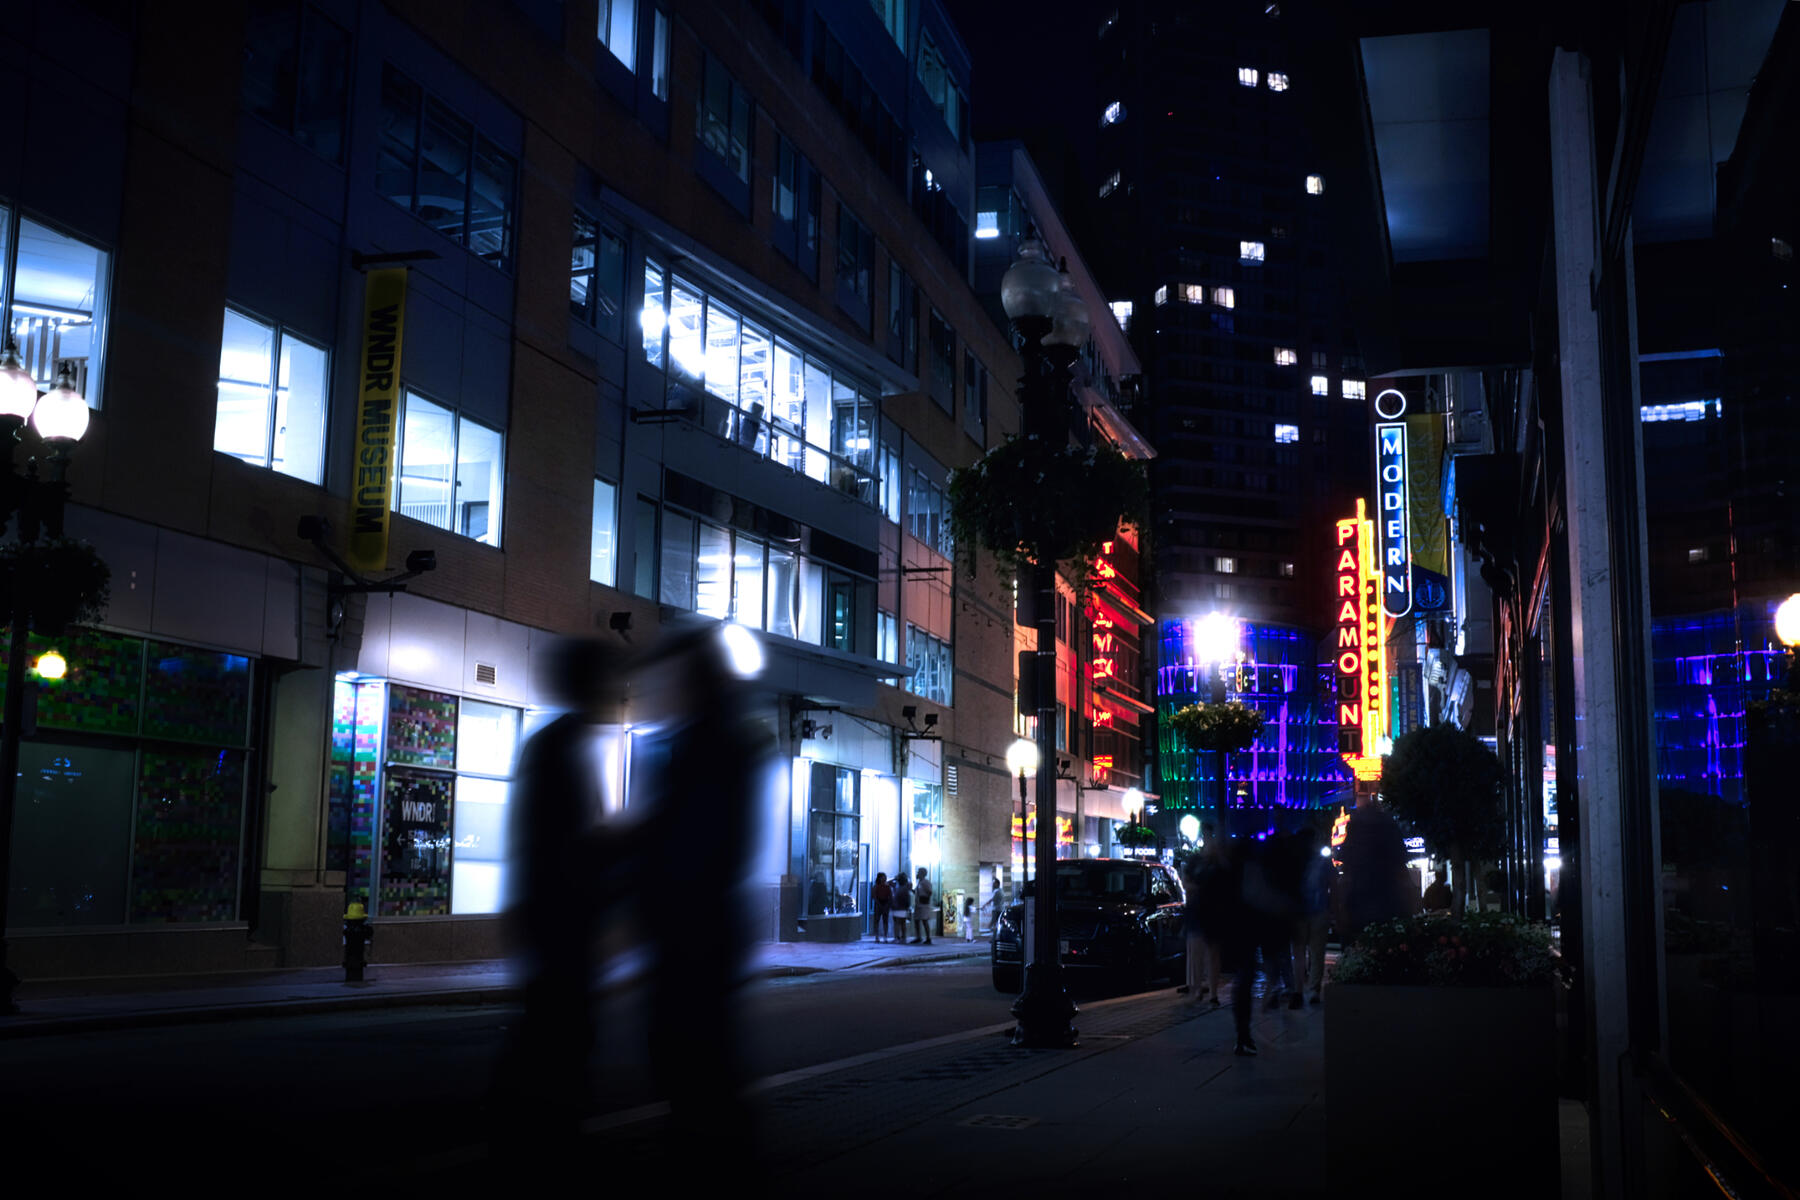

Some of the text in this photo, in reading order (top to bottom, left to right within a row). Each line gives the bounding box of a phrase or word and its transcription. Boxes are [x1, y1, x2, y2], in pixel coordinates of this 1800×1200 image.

[355, 303, 399, 533] WNDR MUSEUM
[1383, 438, 1404, 594] MODERN
[1337, 525, 1360, 751] PARAMOUNT
